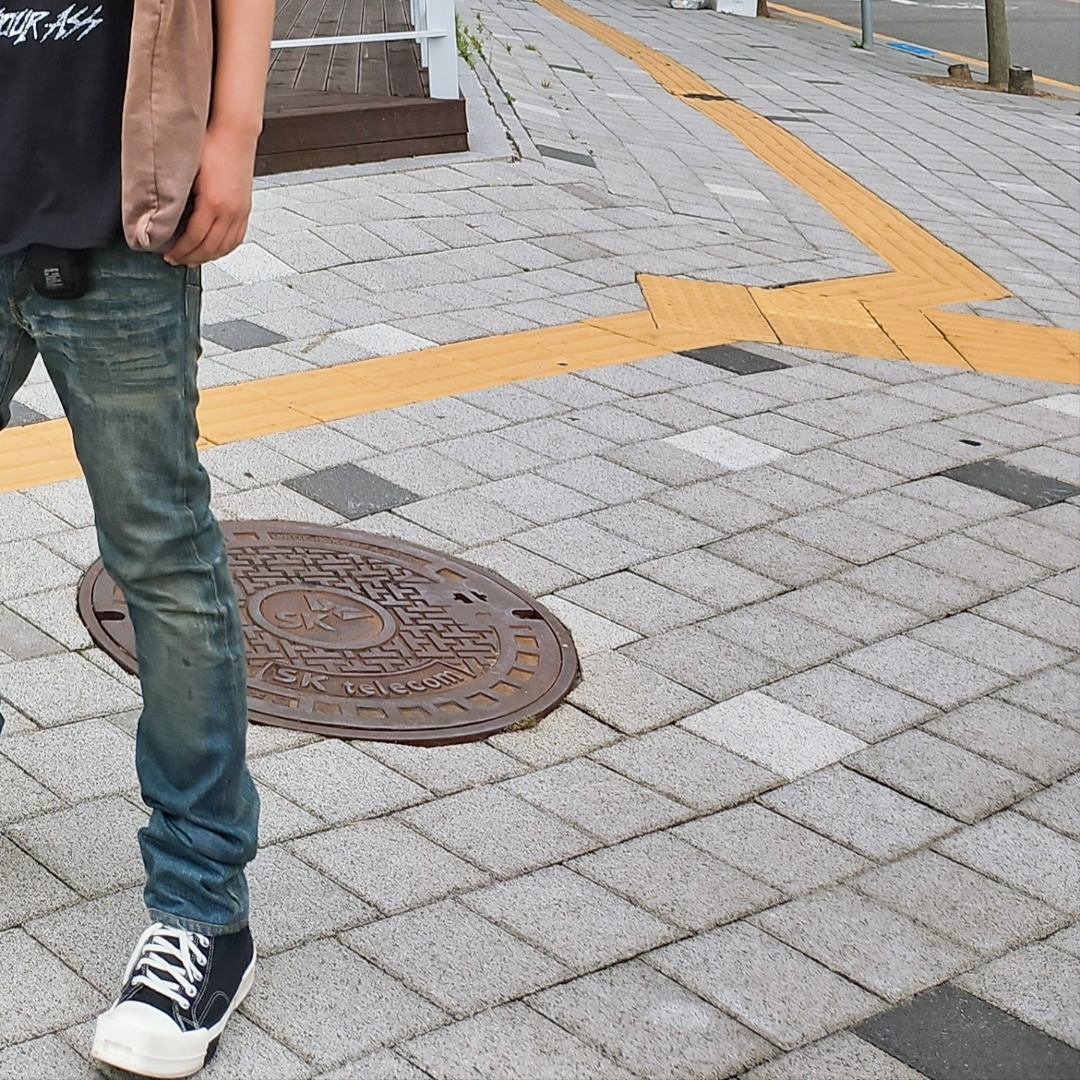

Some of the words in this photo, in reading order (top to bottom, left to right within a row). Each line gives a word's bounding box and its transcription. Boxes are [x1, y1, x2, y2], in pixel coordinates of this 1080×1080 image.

[40, 2, 104, 42] ASS
[275, 611, 336, 631] SK
[273, 667, 329, 691] SK
[344, 669, 464, 697] telecom
